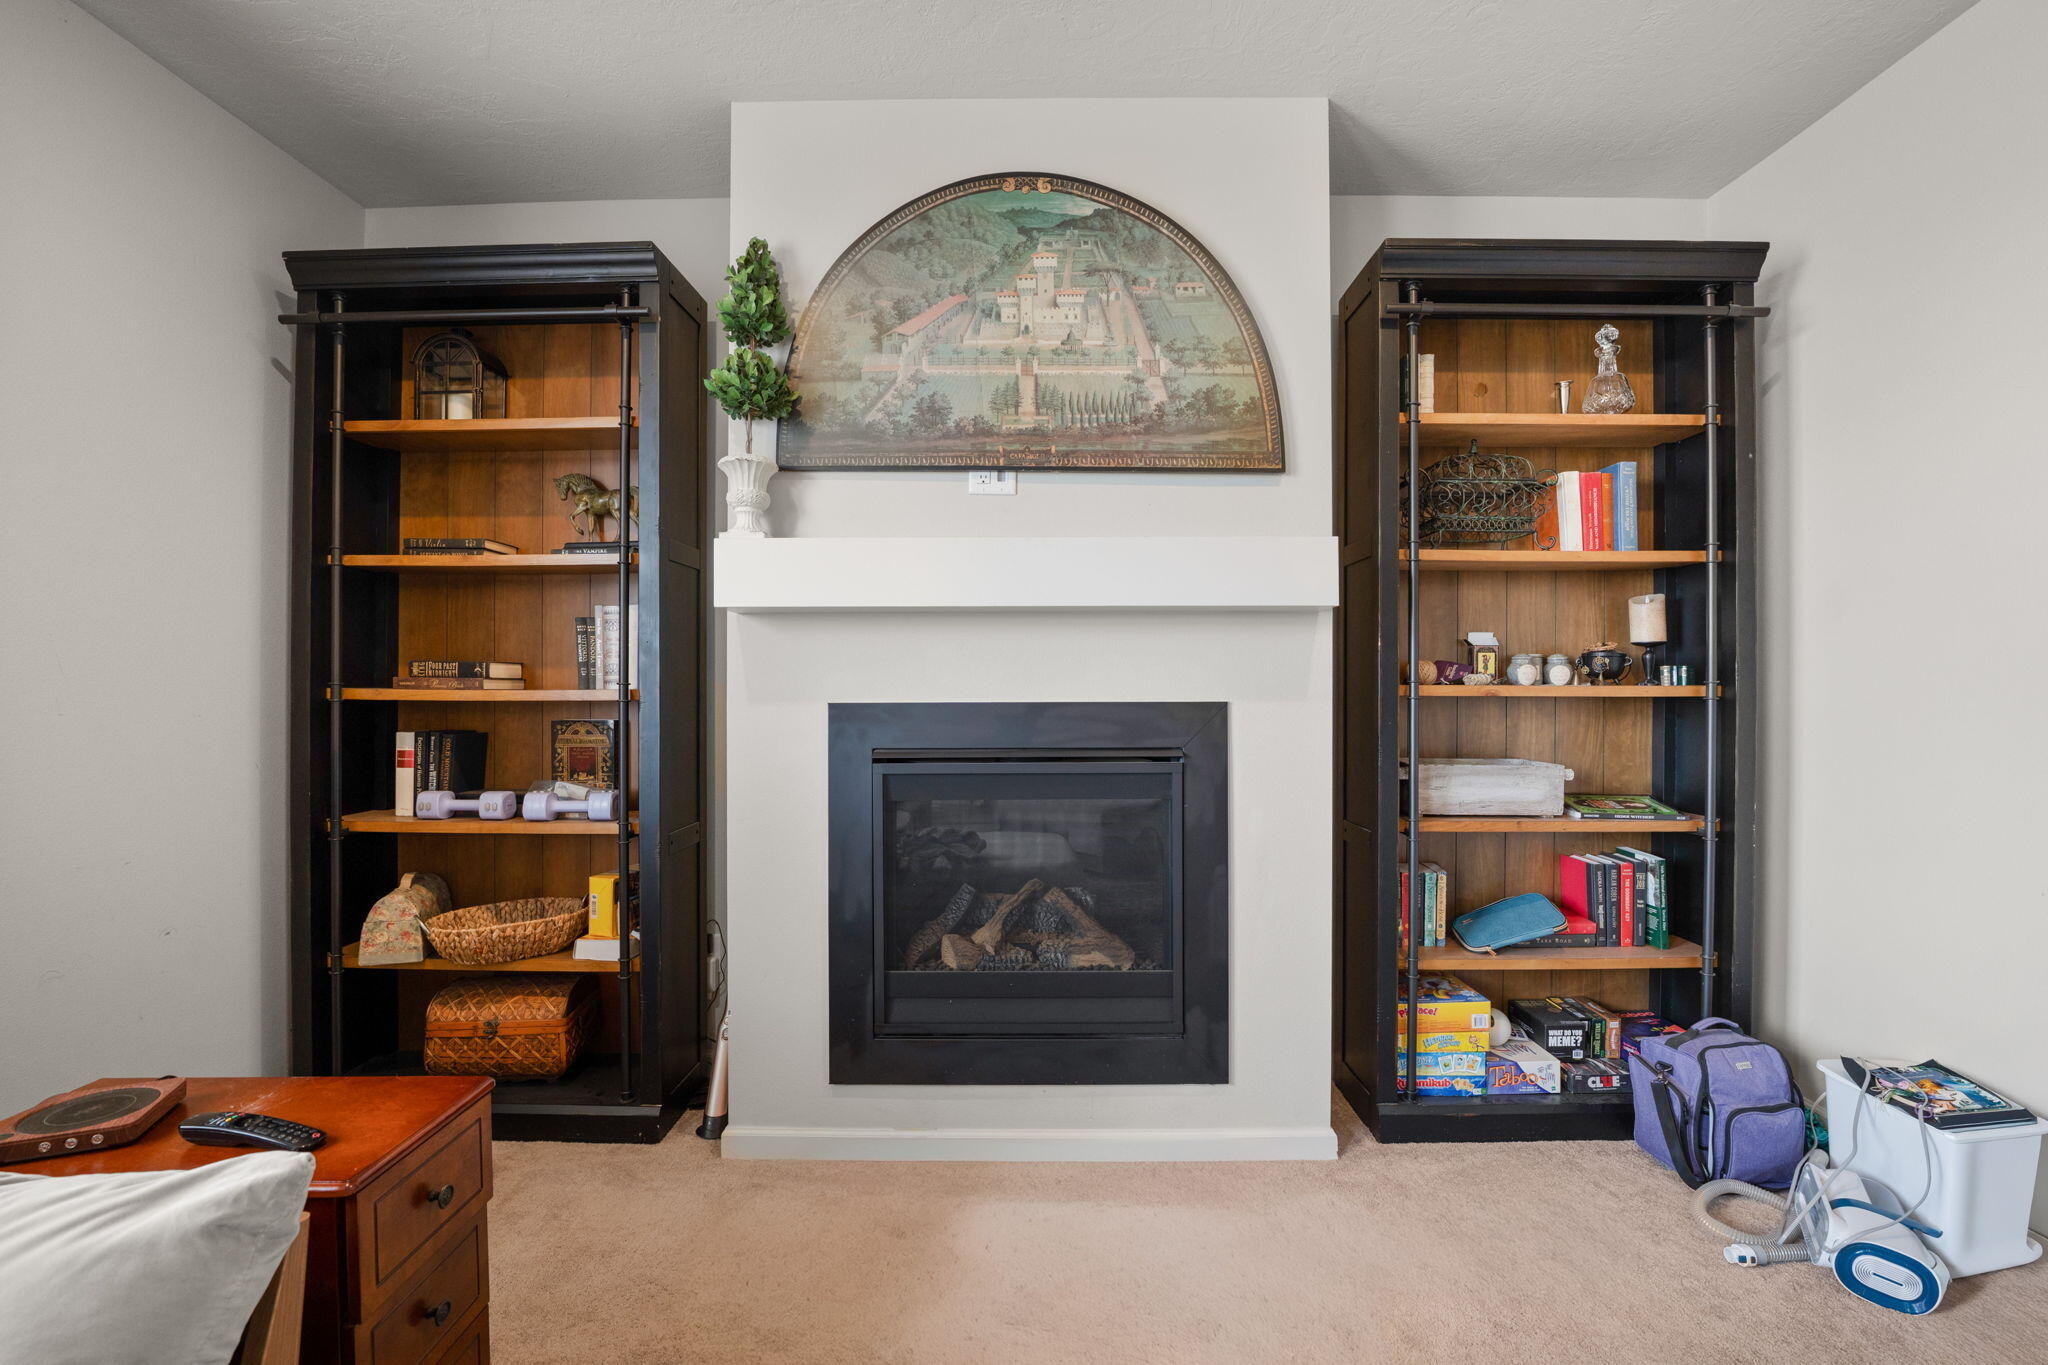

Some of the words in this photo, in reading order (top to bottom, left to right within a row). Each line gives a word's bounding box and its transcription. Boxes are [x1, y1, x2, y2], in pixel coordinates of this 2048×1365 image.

[428, 661, 442, 670] FOUR
[443, 661, 456, 670] PAST
[1548, 1036, 1583, 1047] MEME?
[1488, 1065, 1539, 1088] Taboo
[1587, 1075, 1620, 1088] CLUE
